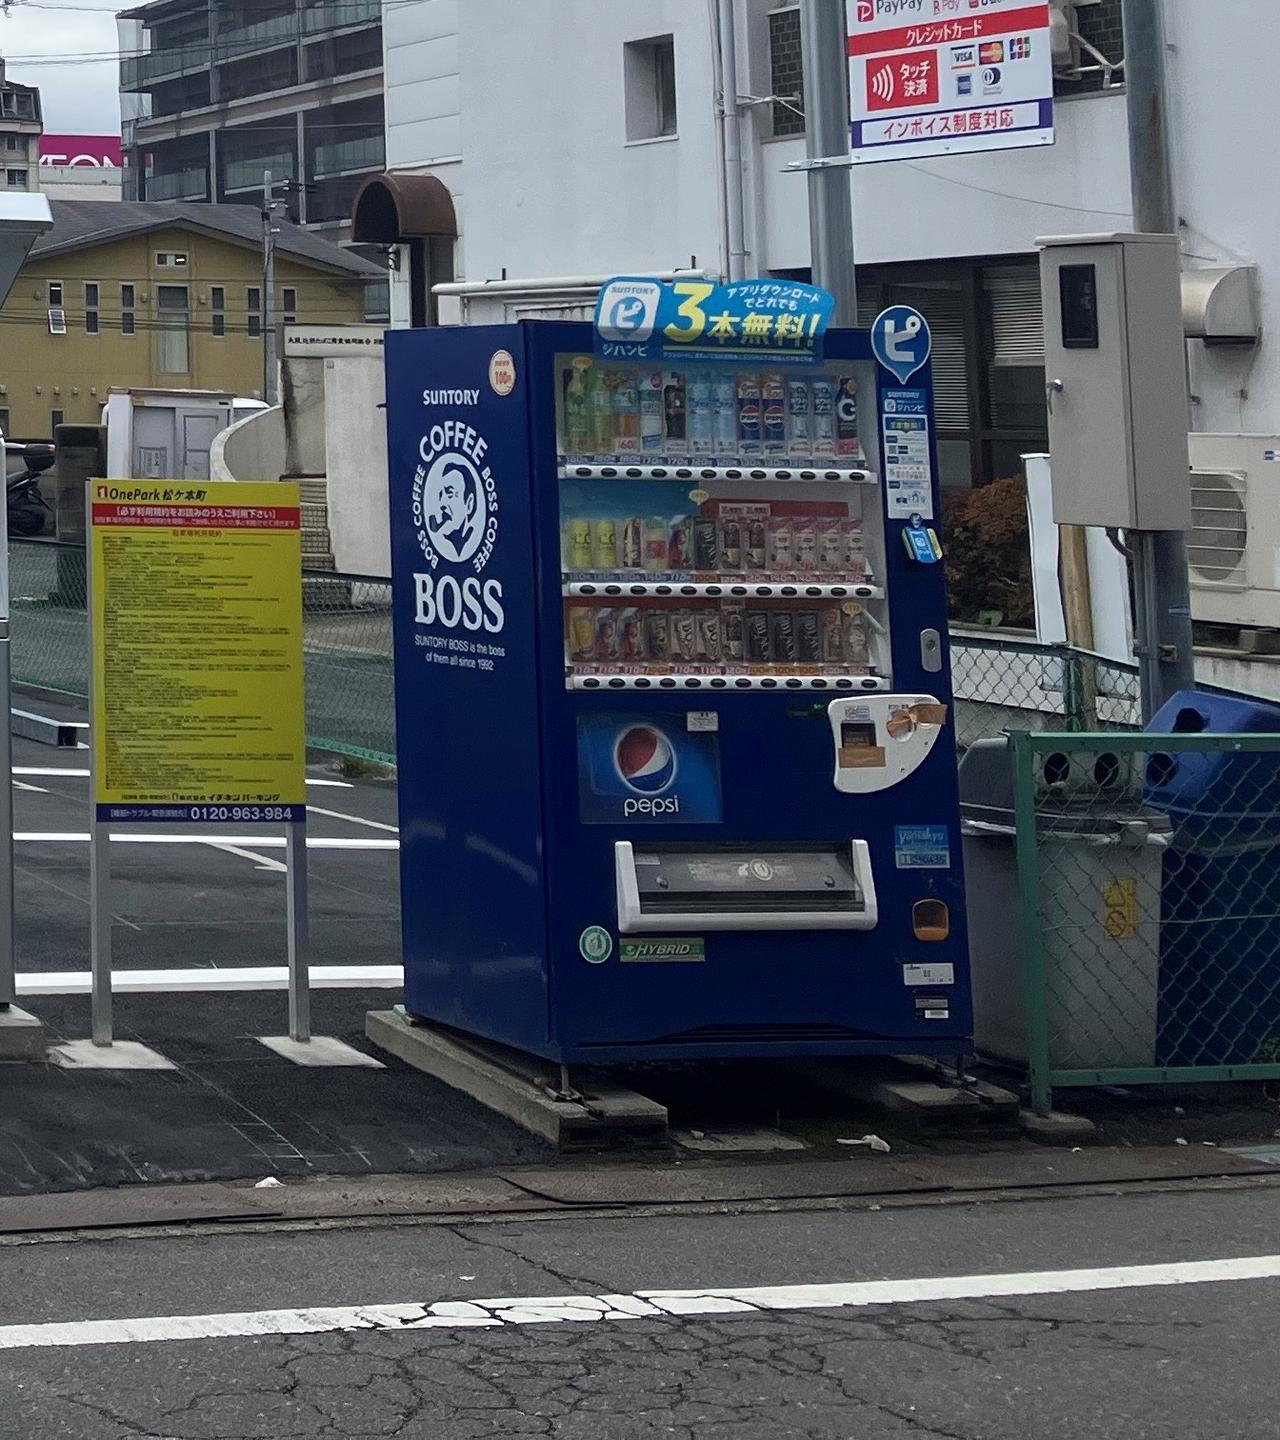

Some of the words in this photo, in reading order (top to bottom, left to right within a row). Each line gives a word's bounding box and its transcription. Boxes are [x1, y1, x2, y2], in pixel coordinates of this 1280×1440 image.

[906, 20, 982, 46] クレジットカード
[899, 60, 931, 80] タッチ
[903, 78, 928, 97] 決済
[884, 109, 1014, 139] インボイス制度対応
[727, 284, 822, 304] アプリダウンロード
[423, 389, 480, 405] SUNTORY
[419, 420, 488, 466] COFFEE
[109, 488, 160, 500] OnePark
[412, 464, 427, 526] COFFEE
[481, 466, 499, 512] BOSS
[417, 529, 439, 569] BOSS
[472, 517, 499, 573] COFFEE
[413, 573, 505, 633] BOSS
[415, 634, 447, 649] SUNTORY
[448, 638, 469, 652] BOSS
[476, 643, 488, 655] the
[488, 644, 506, 657] boss
[433, 652, 449, 664] them
[459, 655, 476, 668] since
[190, 807, 292, 820] 0120-963-984
[624, 795, 679, 817] pepsi
[635, 944, 690, 959] HYBRID
